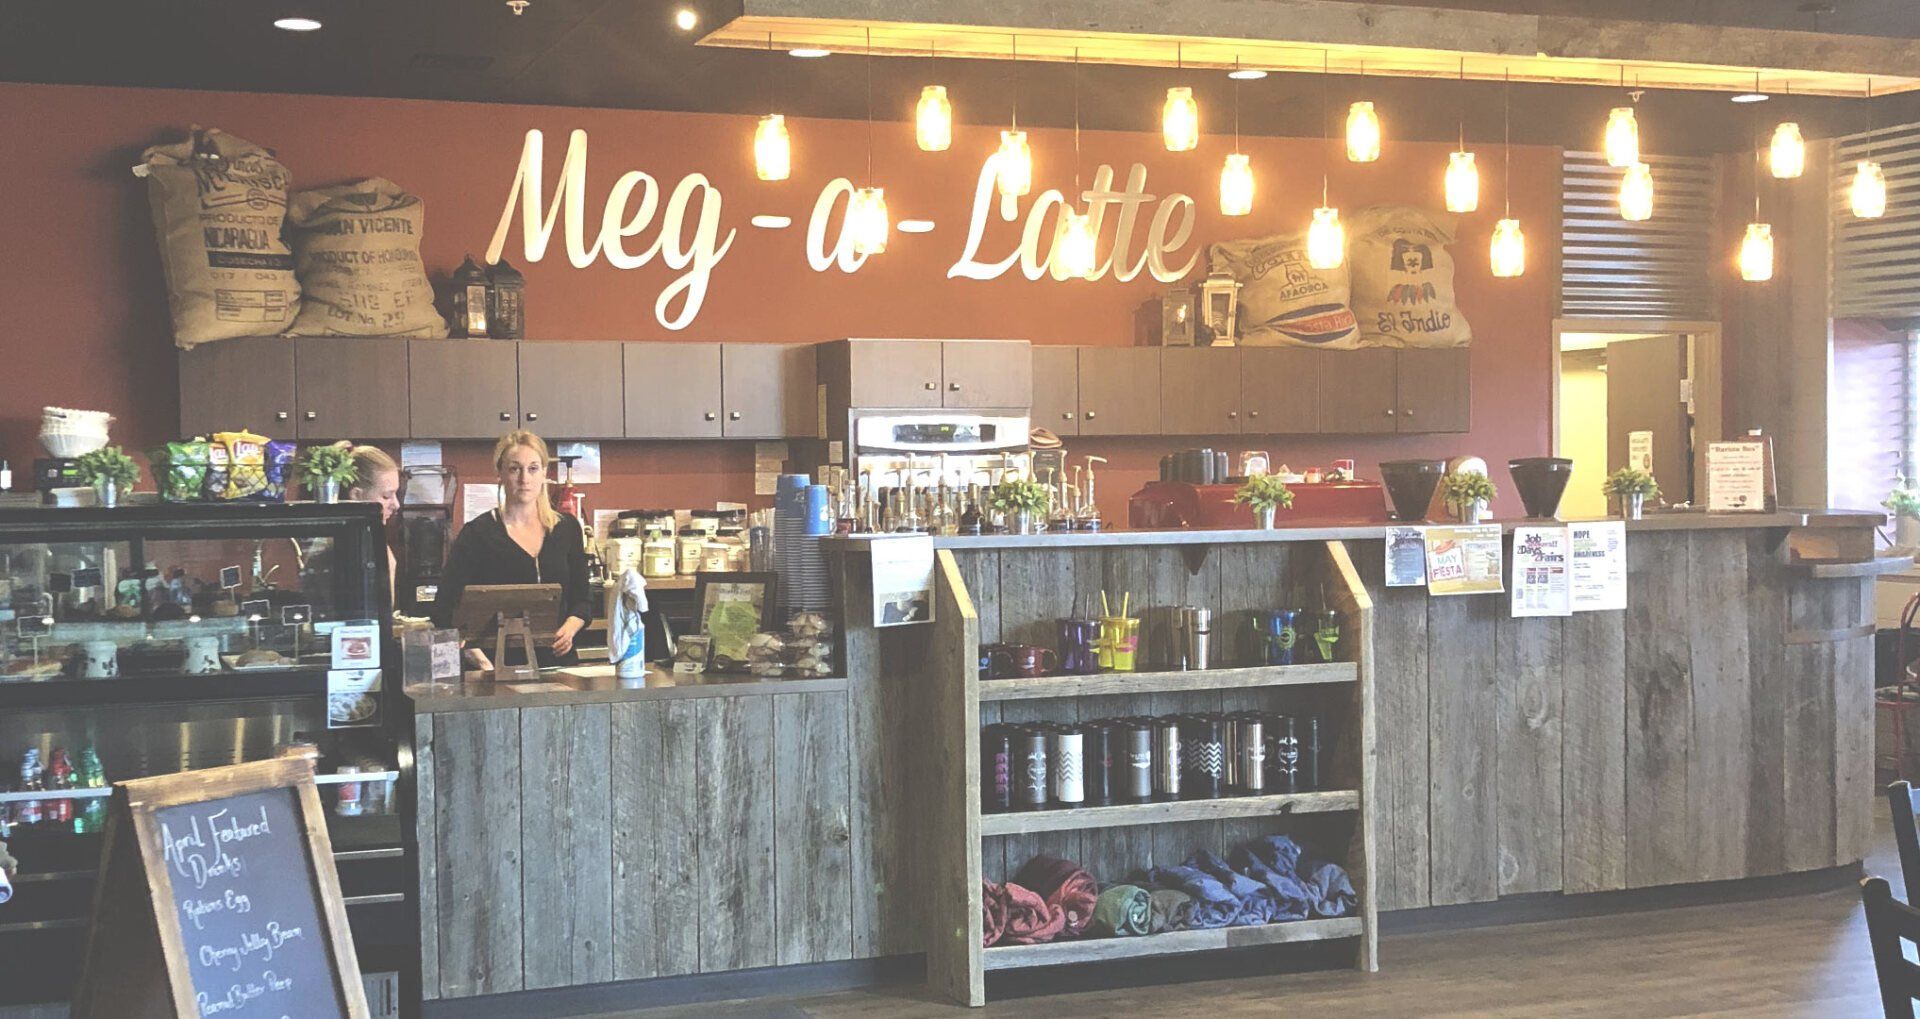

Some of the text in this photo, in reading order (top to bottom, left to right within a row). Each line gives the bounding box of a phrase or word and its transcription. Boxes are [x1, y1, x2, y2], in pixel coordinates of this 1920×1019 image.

[359, 217, 413, 235] VICENTE
[203, 226, 270, 250] NICARAGUA
[361, 251, 376, 264] OF
[1525, 533, 1542, 544] Job
[1573, 530, 1591, 540] HOPE
[1437, 553, 1457, 564] MAY
[1432, 565, 1463, 578] FIESTA
[161, 805, 272, 878] April Featured
[224, 889, 251, 913] Egg
